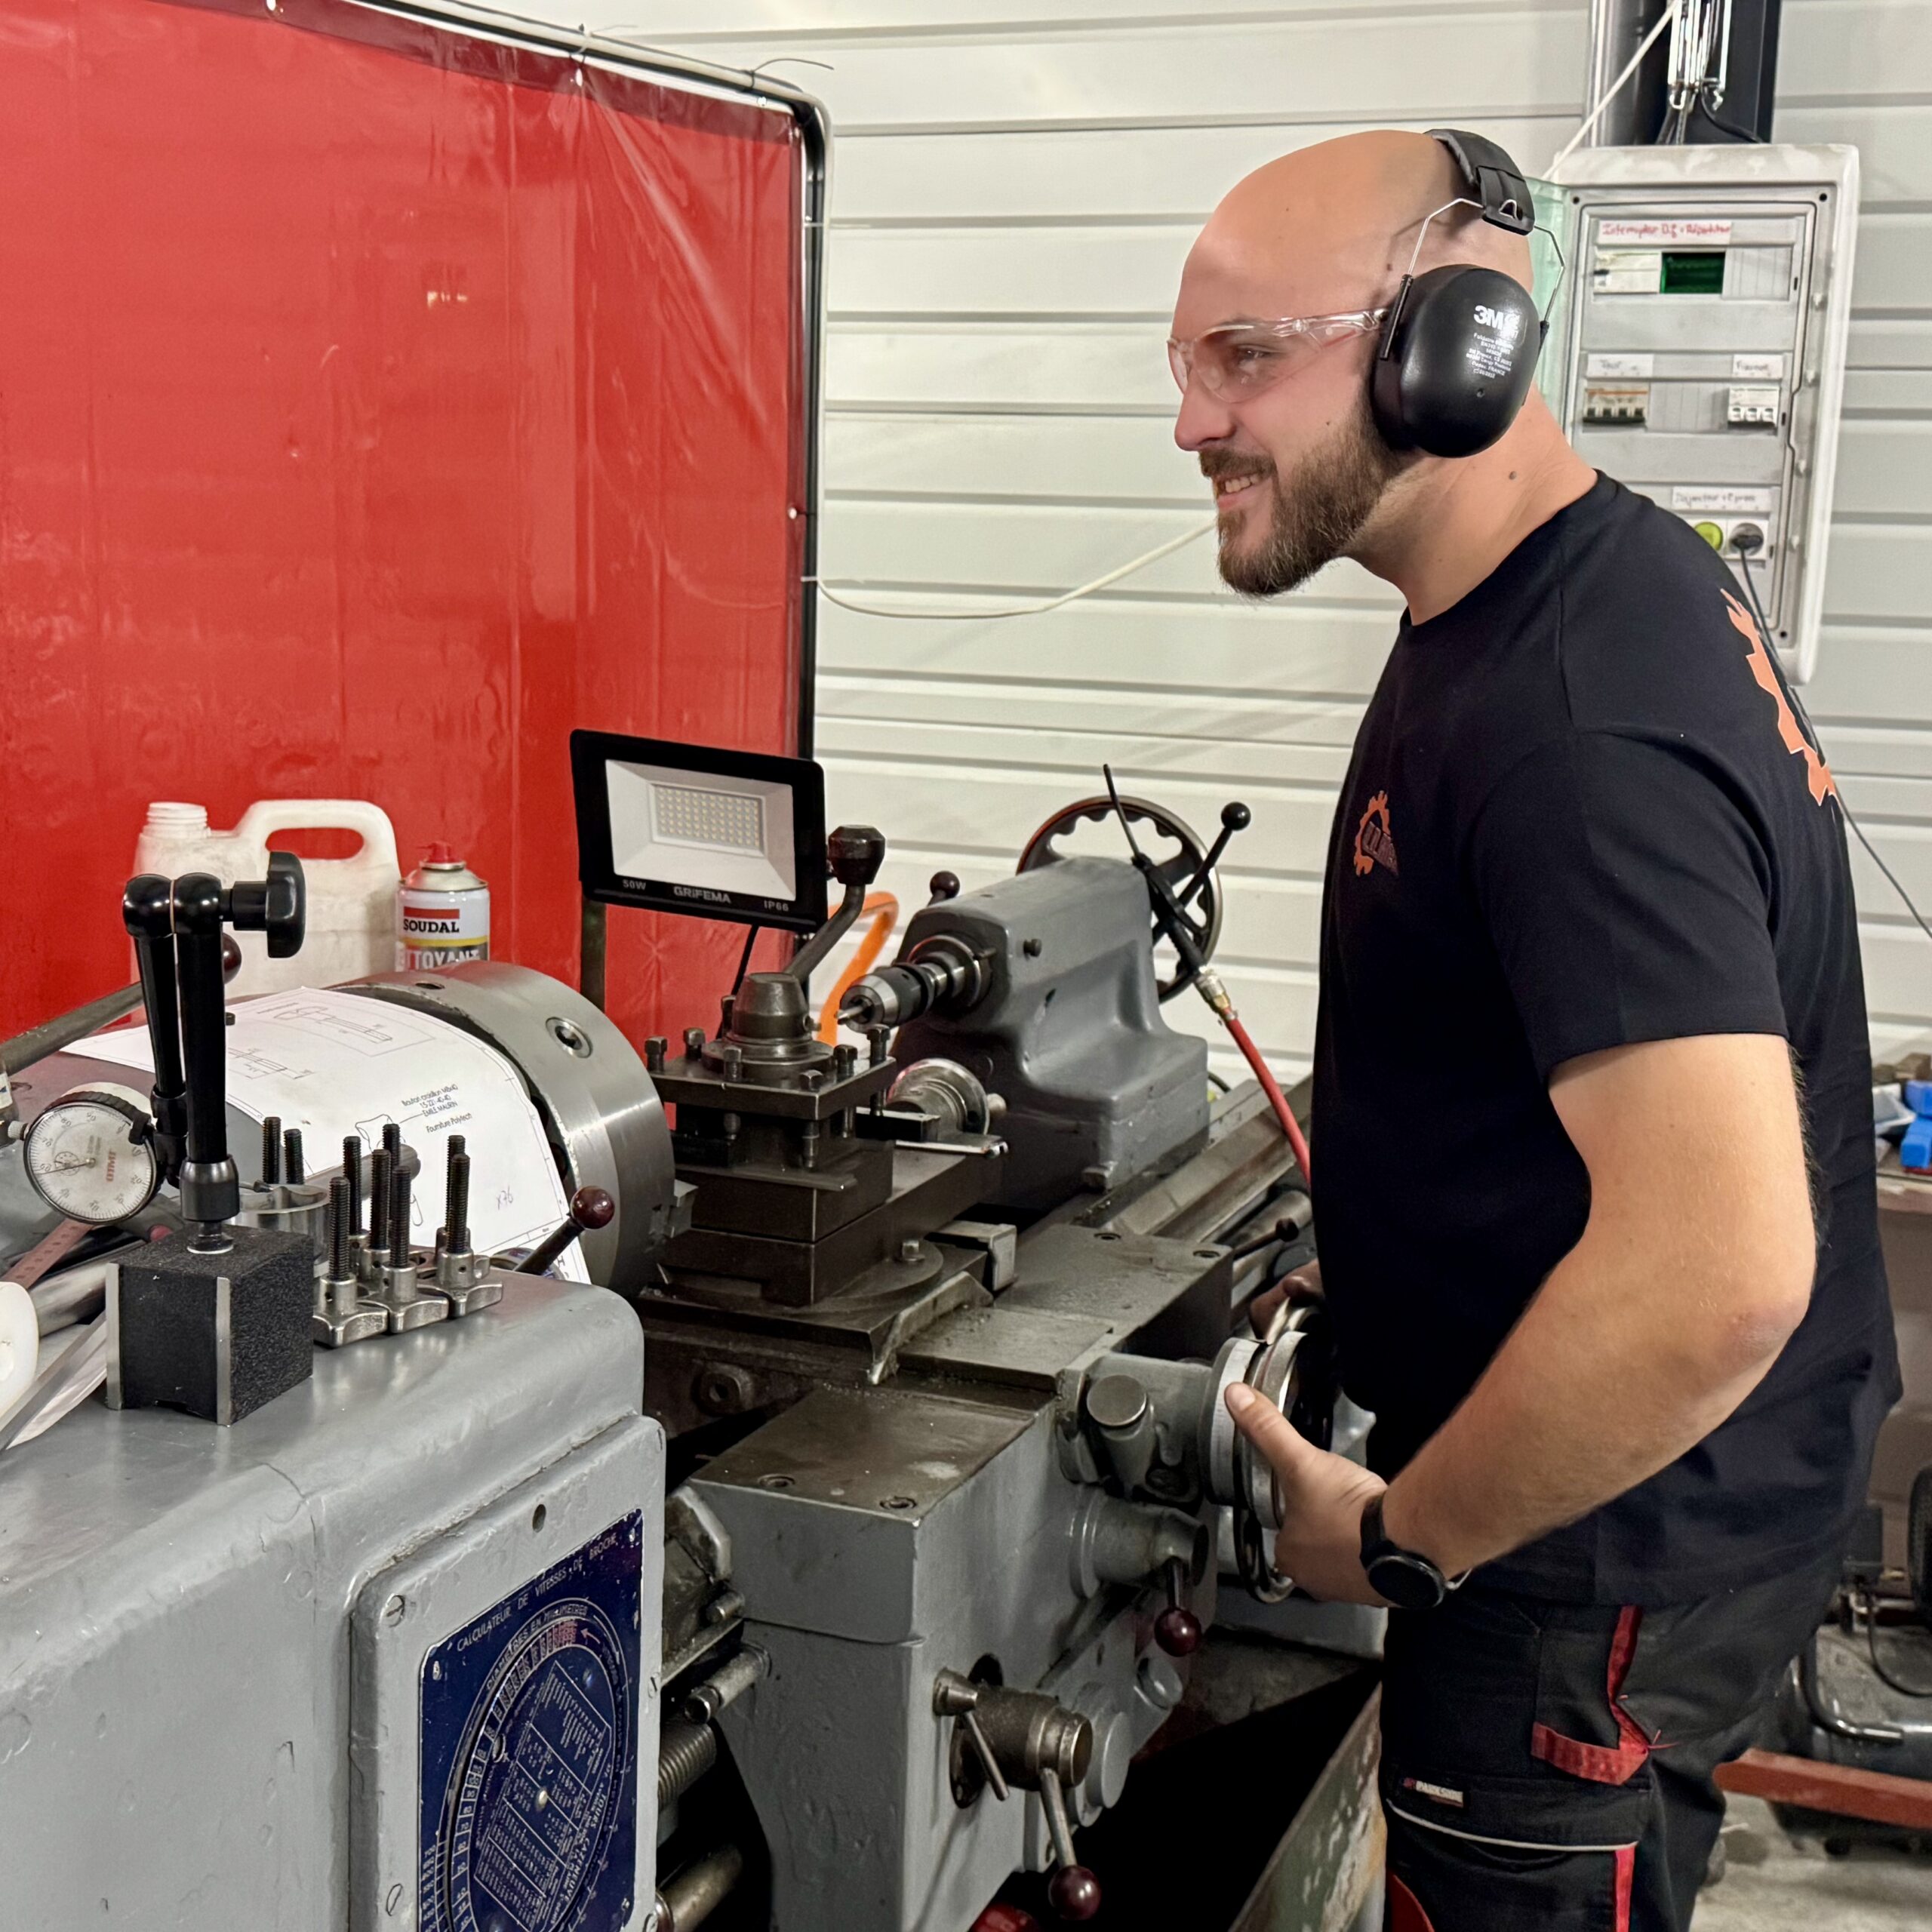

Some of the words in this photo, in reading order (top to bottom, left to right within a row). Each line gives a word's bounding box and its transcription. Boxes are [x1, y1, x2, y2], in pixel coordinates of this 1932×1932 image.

[1473, 305, 1503, 330] 3M
[623, 879, 647, 891] 50W
[764, 900, 789, 912] IP66
[403, 918, 460, 934] SOUDAL
[426, 1120, 451, 1133] Fourniture
[451, 1112, 472, 1124] Polytech
[457, 1608, 511, 1652] CALCULATEUR
[518, 1593, 529, 1608] DE
[534, 1567, 568, 1597] VITESSES
[573, 1556, 583, 1572] DE
[589, 1533, 617, 1561] BROCHE
[530, 1617, 542, 1629] EN
[591, 1794, 606, 1829] TOURS
[460, 1822, 469, 1830] 70
[565, 1838, 590, 1903] CAZENEUVE
